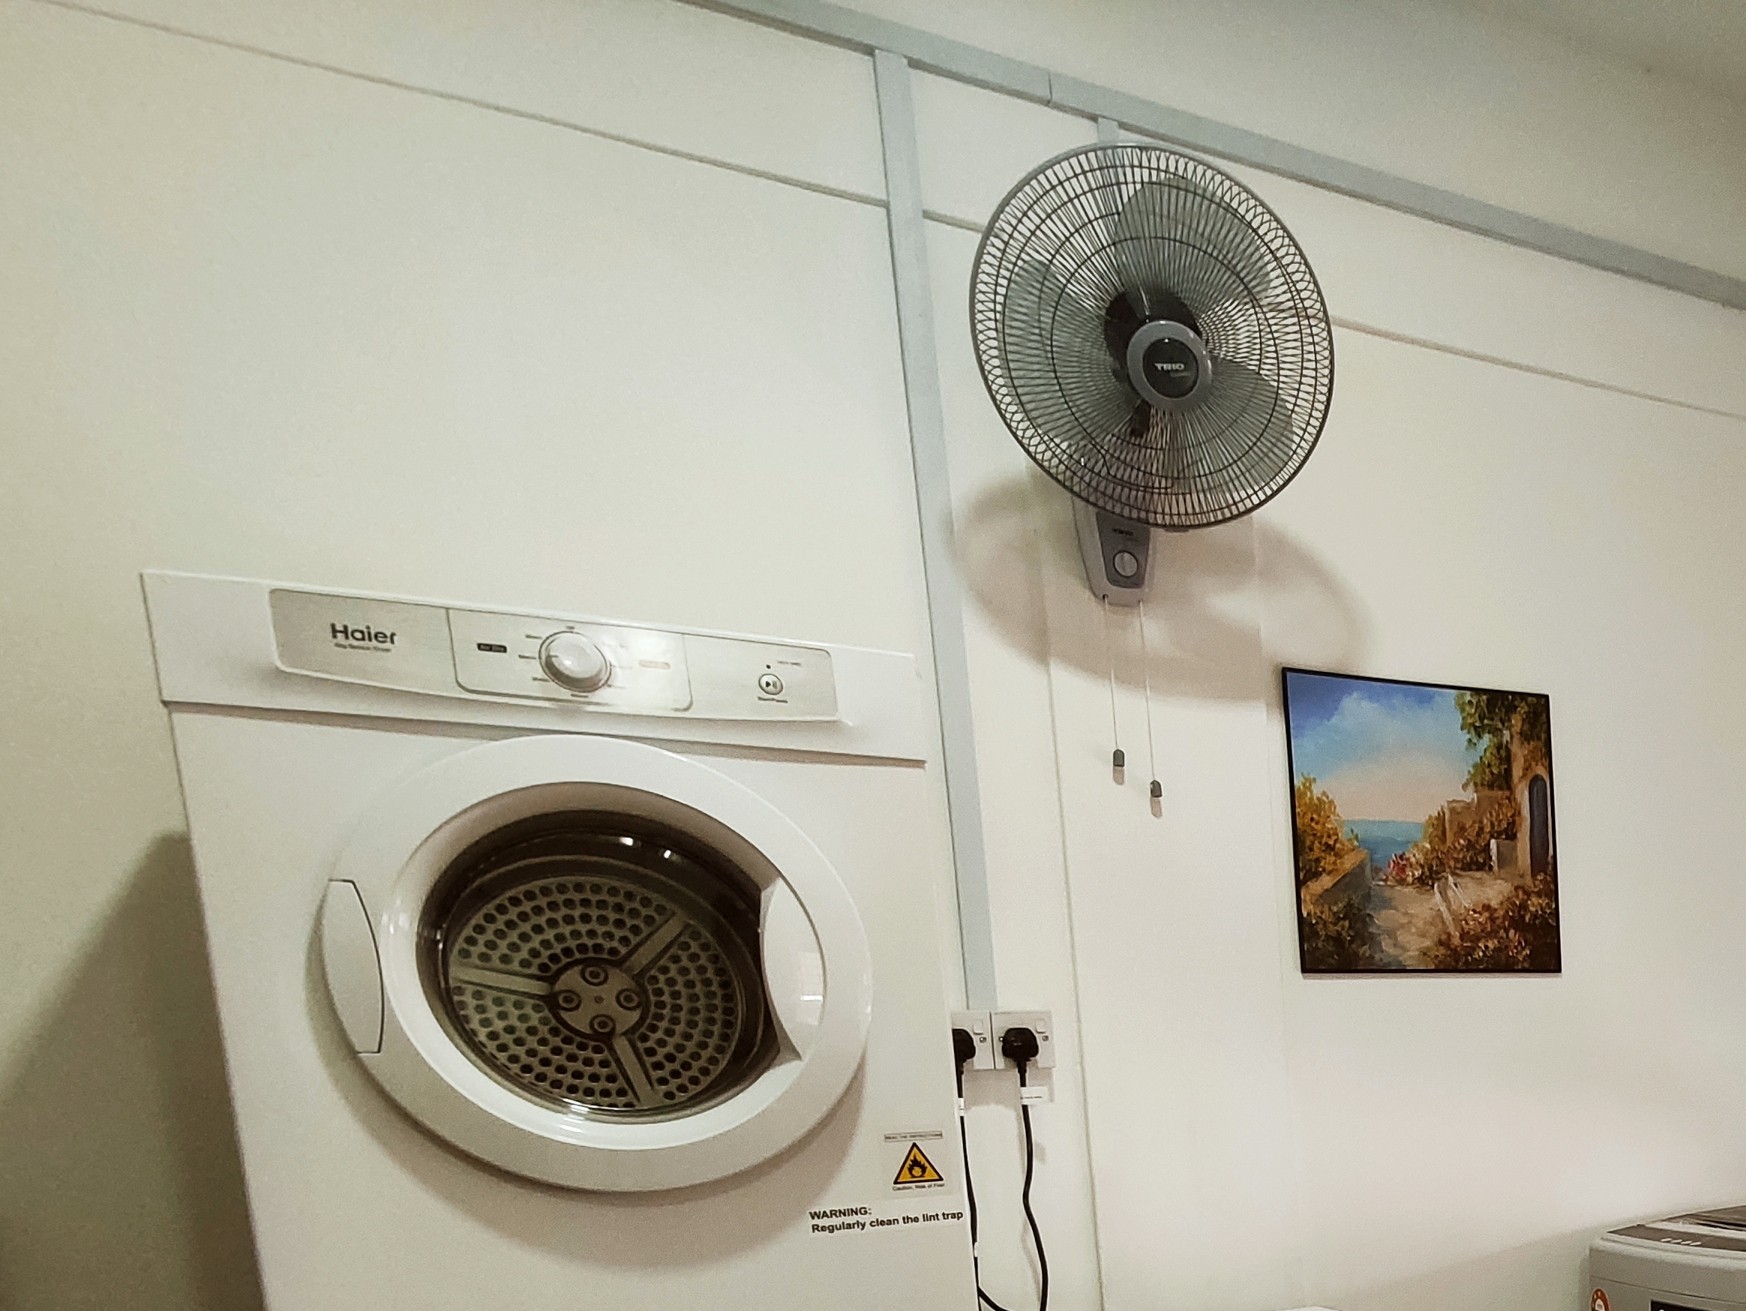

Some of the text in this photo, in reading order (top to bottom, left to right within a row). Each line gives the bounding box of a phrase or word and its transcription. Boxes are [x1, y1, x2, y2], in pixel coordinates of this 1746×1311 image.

[1154, 362, 1185, 371] TRIO
[330, 622, 397, 645] Haier
[809, 1206, 872, 1220] WARNING:
[811, 1210, 964, 1233] Regularly clean the lint trap
